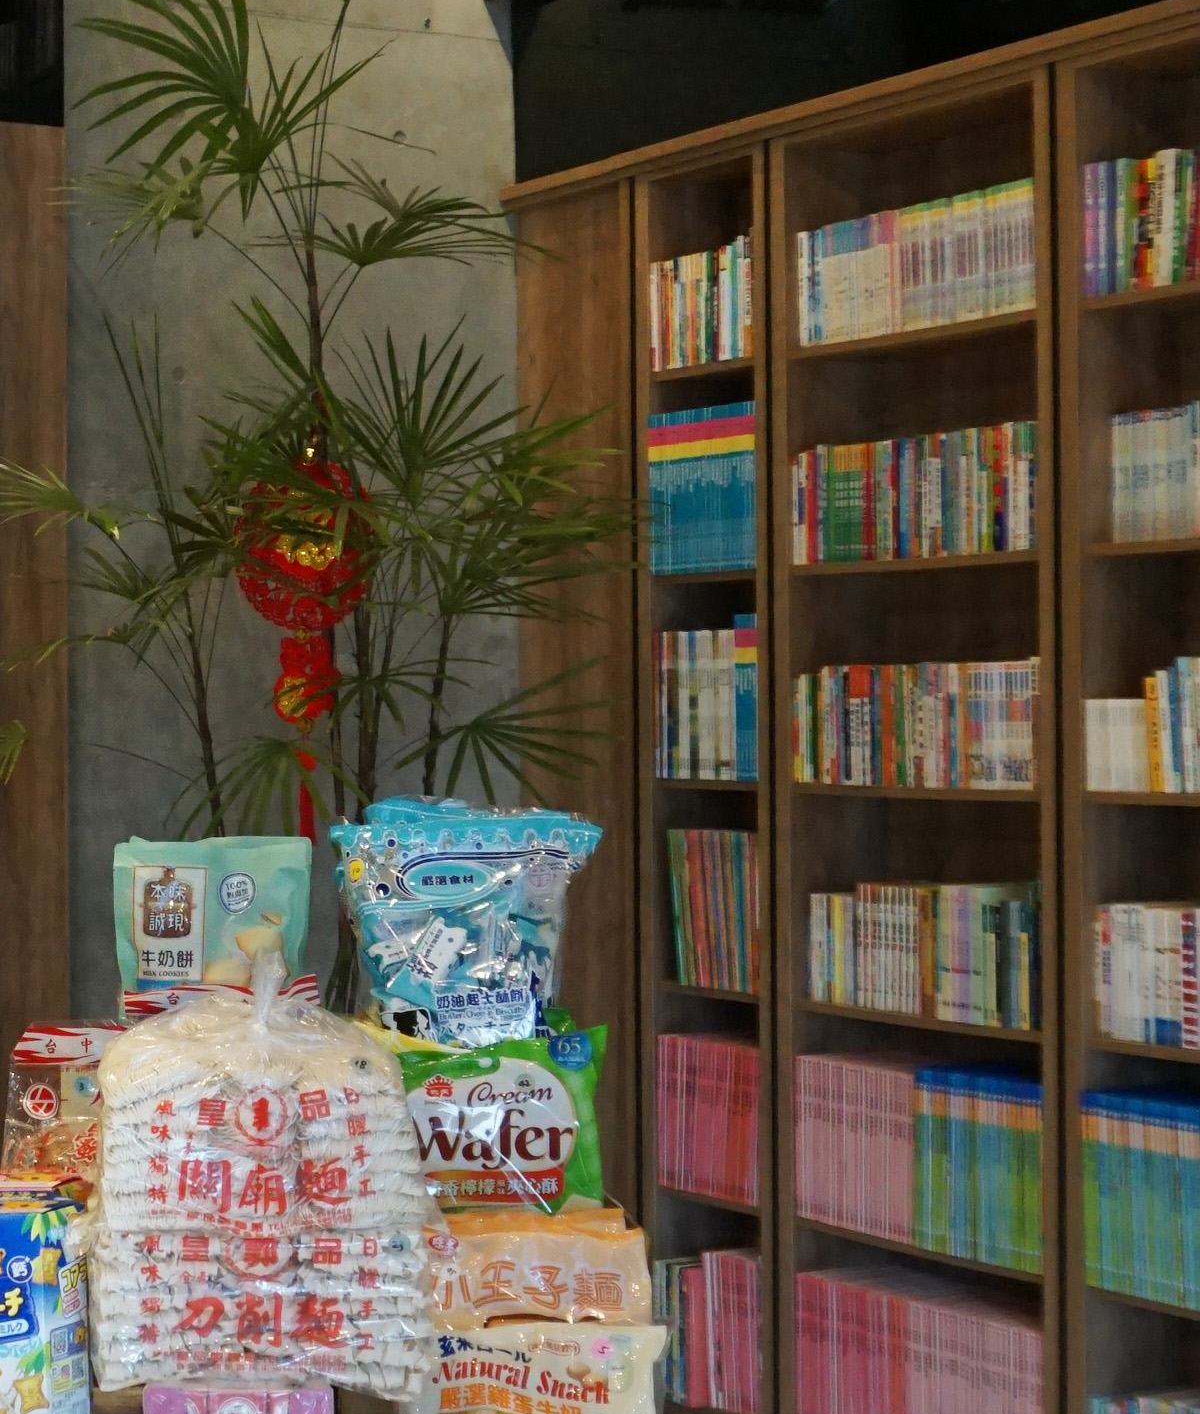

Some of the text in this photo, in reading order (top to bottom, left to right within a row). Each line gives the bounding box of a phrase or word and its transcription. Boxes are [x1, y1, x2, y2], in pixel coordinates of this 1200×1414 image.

[150, 883, 187, 902] 本味
[421, 873, 475, 887] 嚴選食材
[141, 949, 194, 969] 牛奶餅
[142, 970, 190, 978] MILK COOKIES
[557, 1037, 582, 1055] 65
[301, 1089, 333, 1122] 品
[466, 1081, 554, 1108] Cream
[411, 1107, 574, 1171] Wafer
[176, 1157, 353, 1217] 關廟麵
[507, 1176, 559, 1195] 夾心酥
[180, 1235, 342, 1265] 皇 品
[430, 1260, 624, 1312] 小王子麵
[176, 1292, 353, 1351] 刀削麵
[436, 1334, 532, 1364] 玄米ロール
[431, 1358, 611, 1405] Natural Snack
